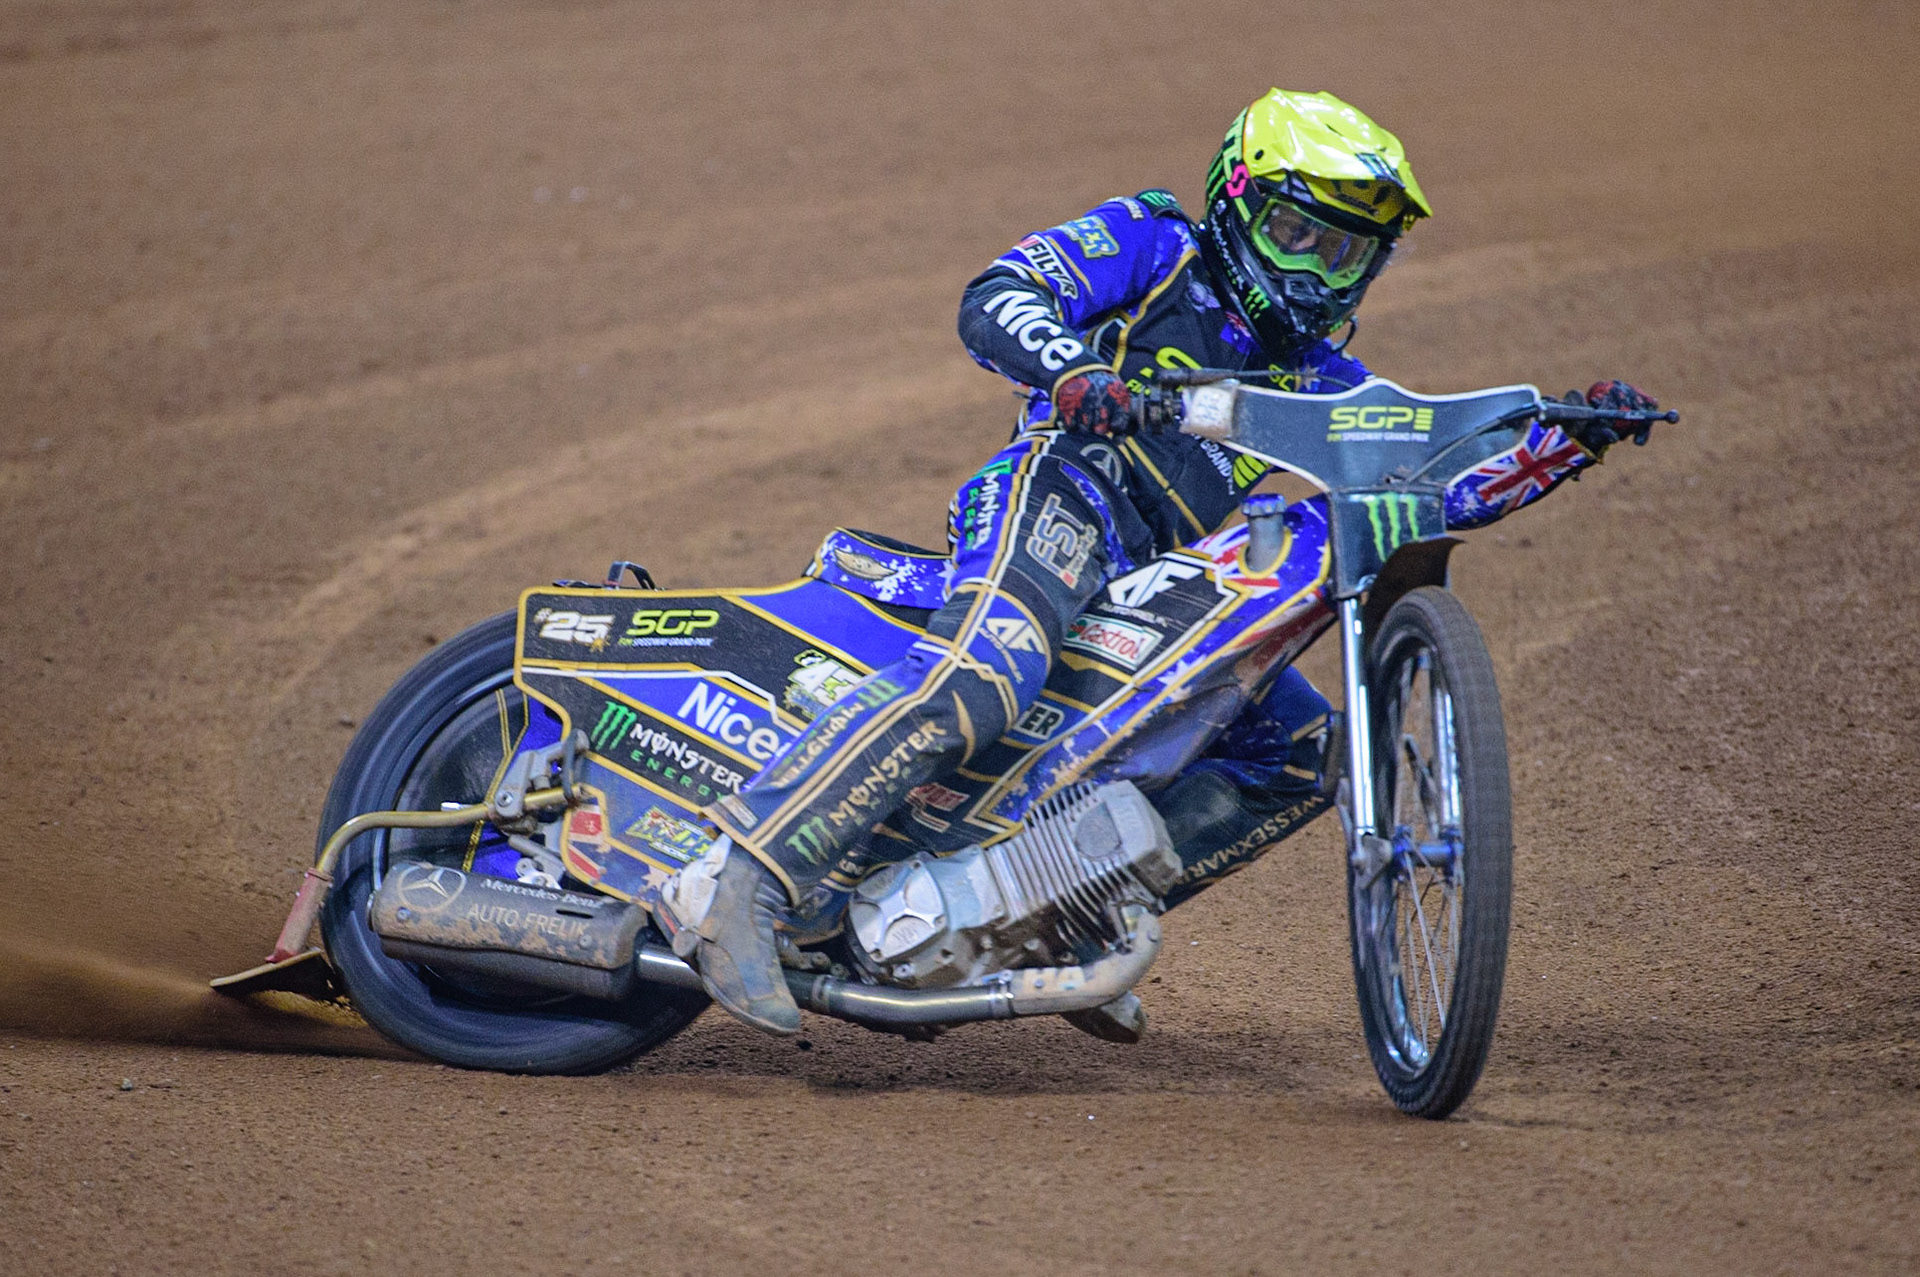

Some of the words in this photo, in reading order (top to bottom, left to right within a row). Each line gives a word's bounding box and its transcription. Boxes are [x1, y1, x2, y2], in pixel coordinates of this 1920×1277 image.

[983, 290, 1084, 371] Nice
[626, 609, 720, 635] SGP
[1077, 623, 1147, 660] Castrol
[677, 682, 780, 760] Nice
[629, 722, 746, 793] MONSTER
[829, 721, 946, 826] MONSTER
[466, 902, 520, 927] AUTO
